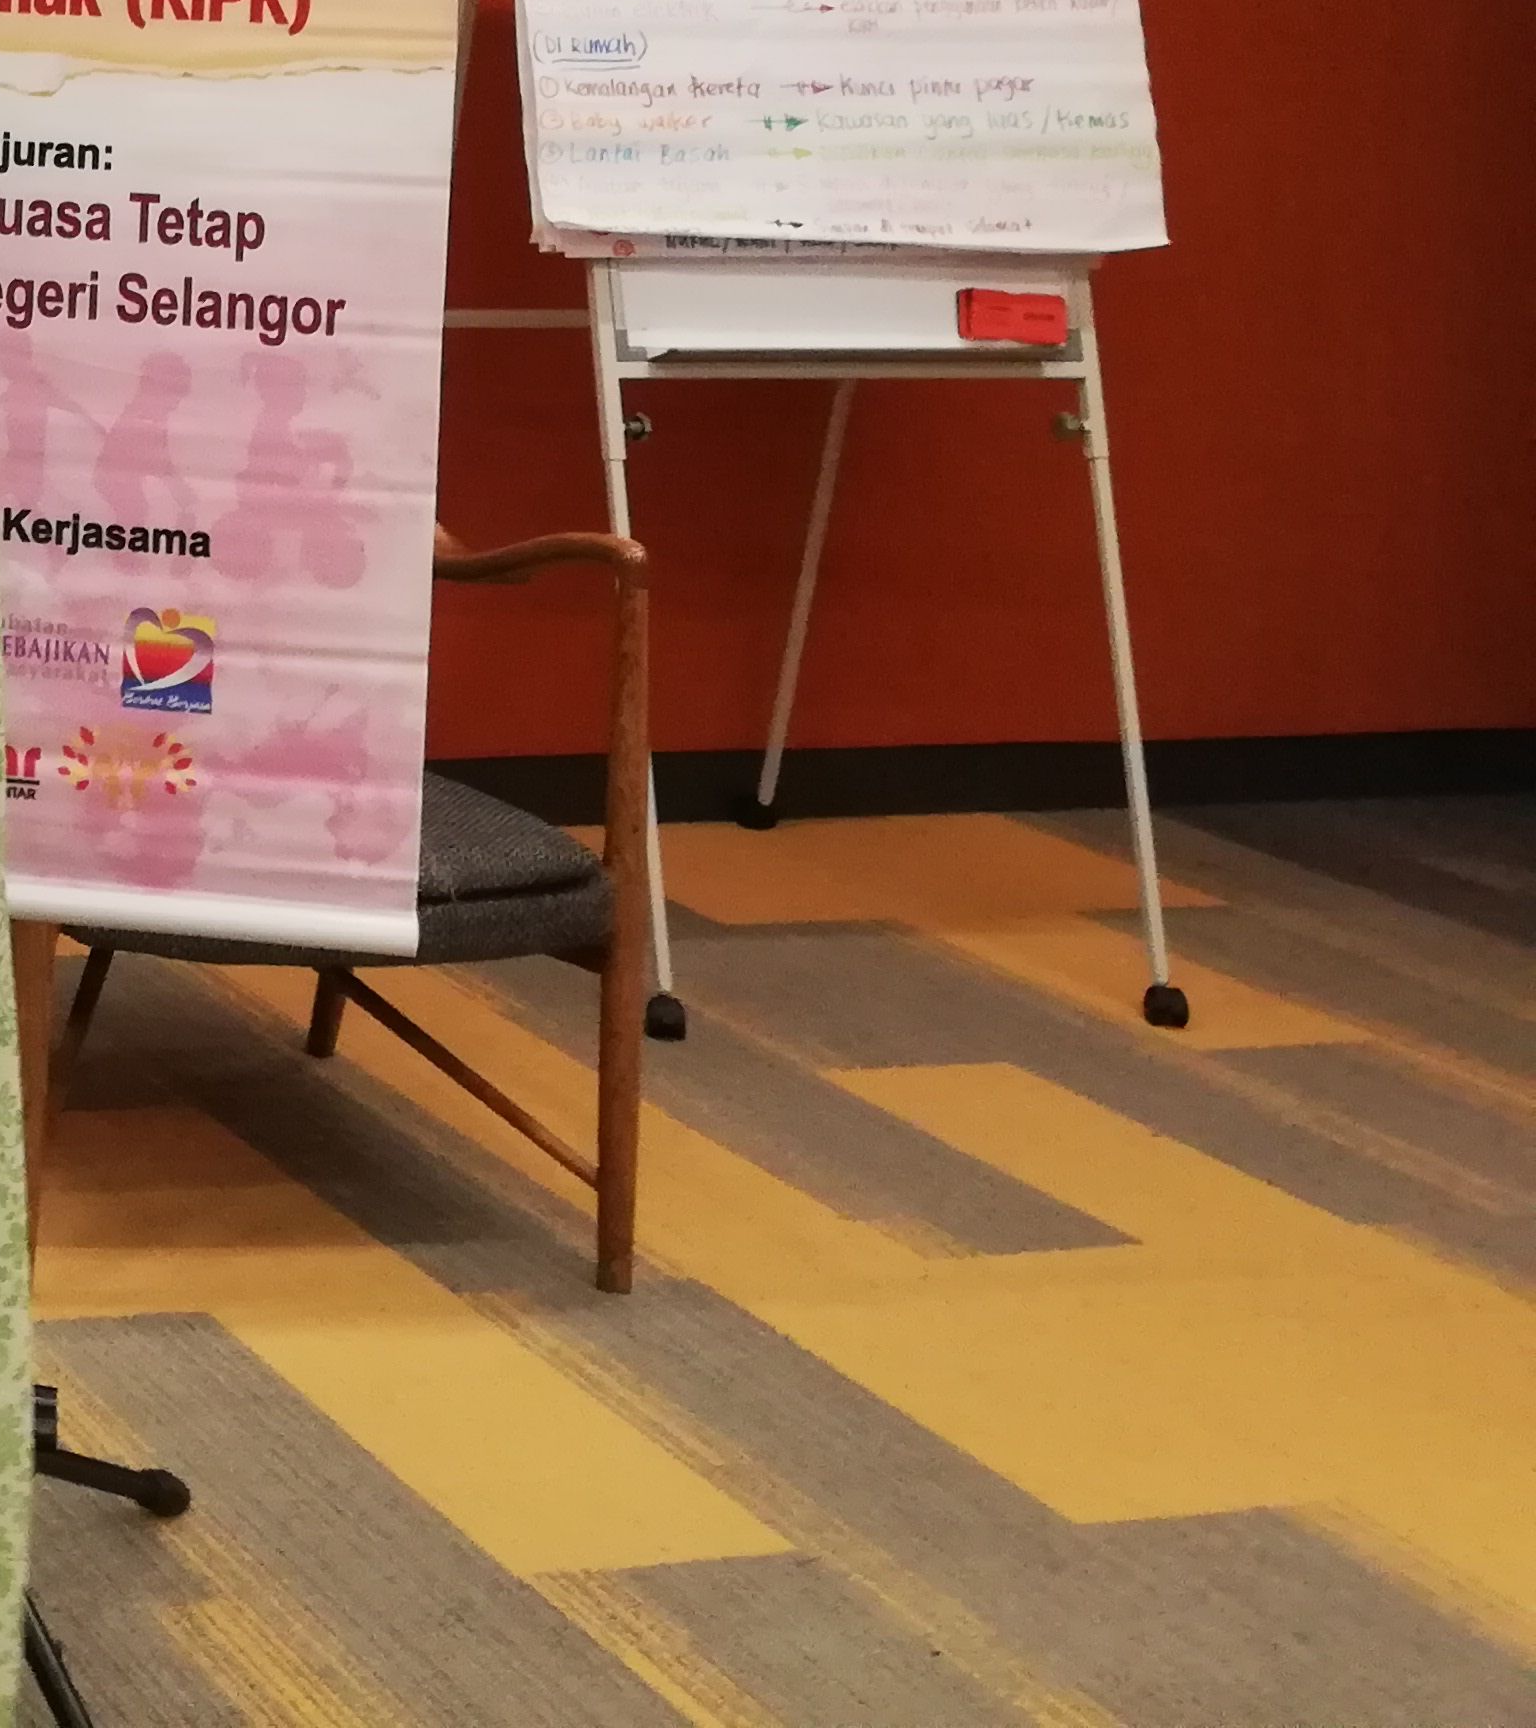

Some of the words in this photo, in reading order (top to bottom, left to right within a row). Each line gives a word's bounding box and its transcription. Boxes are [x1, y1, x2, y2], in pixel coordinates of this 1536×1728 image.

[129, 191, 265, 262] Tetap
[116, 272, 347, 347] Selangor
[2, 507, 212, 558] Kerjasama
[1, 635, 111, 665] EBAJIKAN
